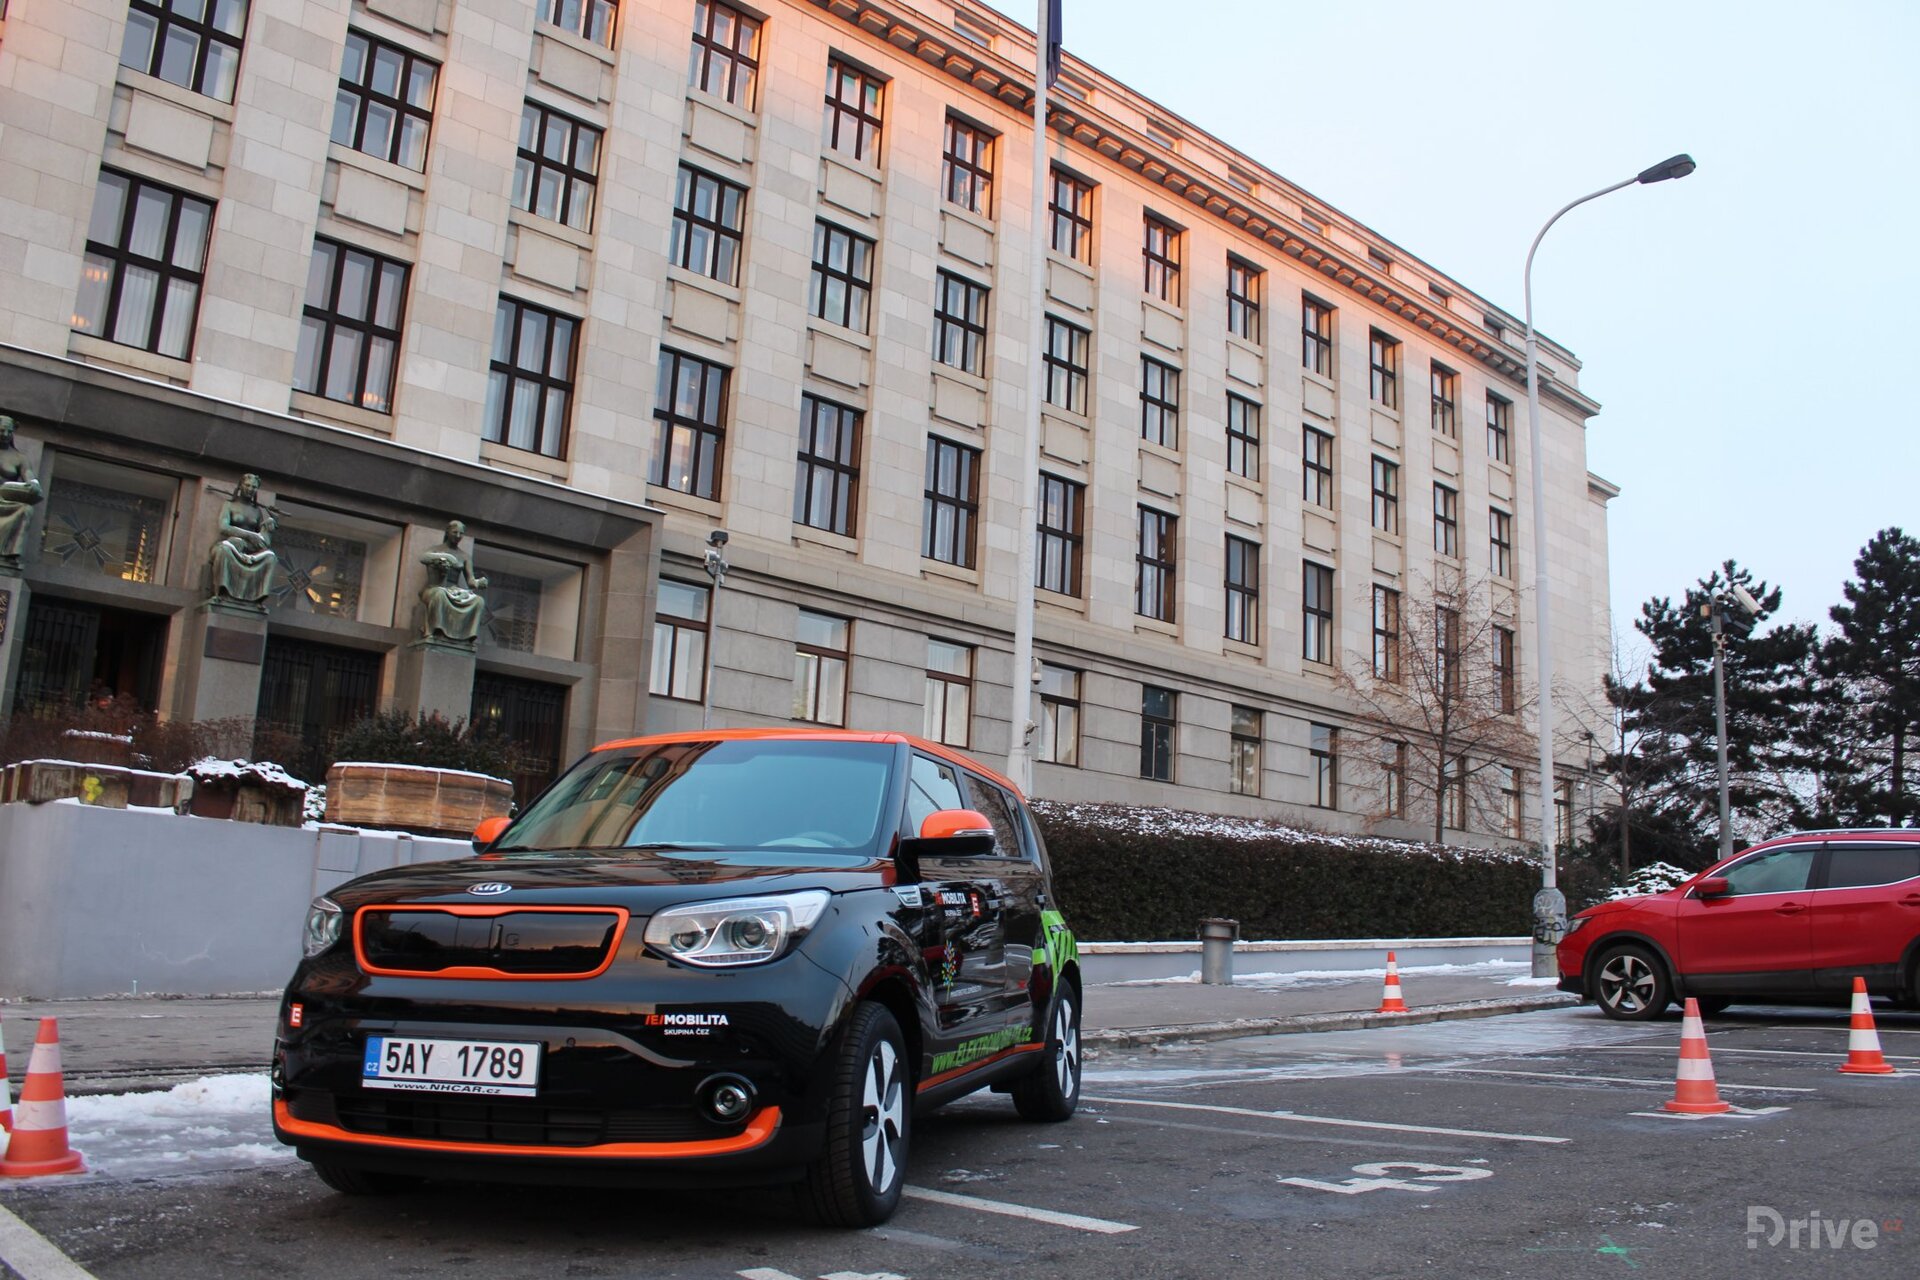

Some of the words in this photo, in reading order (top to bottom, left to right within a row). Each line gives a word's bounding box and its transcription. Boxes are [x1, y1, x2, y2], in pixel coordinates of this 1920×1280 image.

[663, 1028, 694, 1036] SKUPINA
[696, 1027, 710, 1036] ČEZ
[386, 1042, 434, 1075] 5AY
[457, 1046, 524, 1079] 1789
[366, 1062, 379, 1072] CZ
[393, 1083, 501, 1095] www.NHCAR.cz
